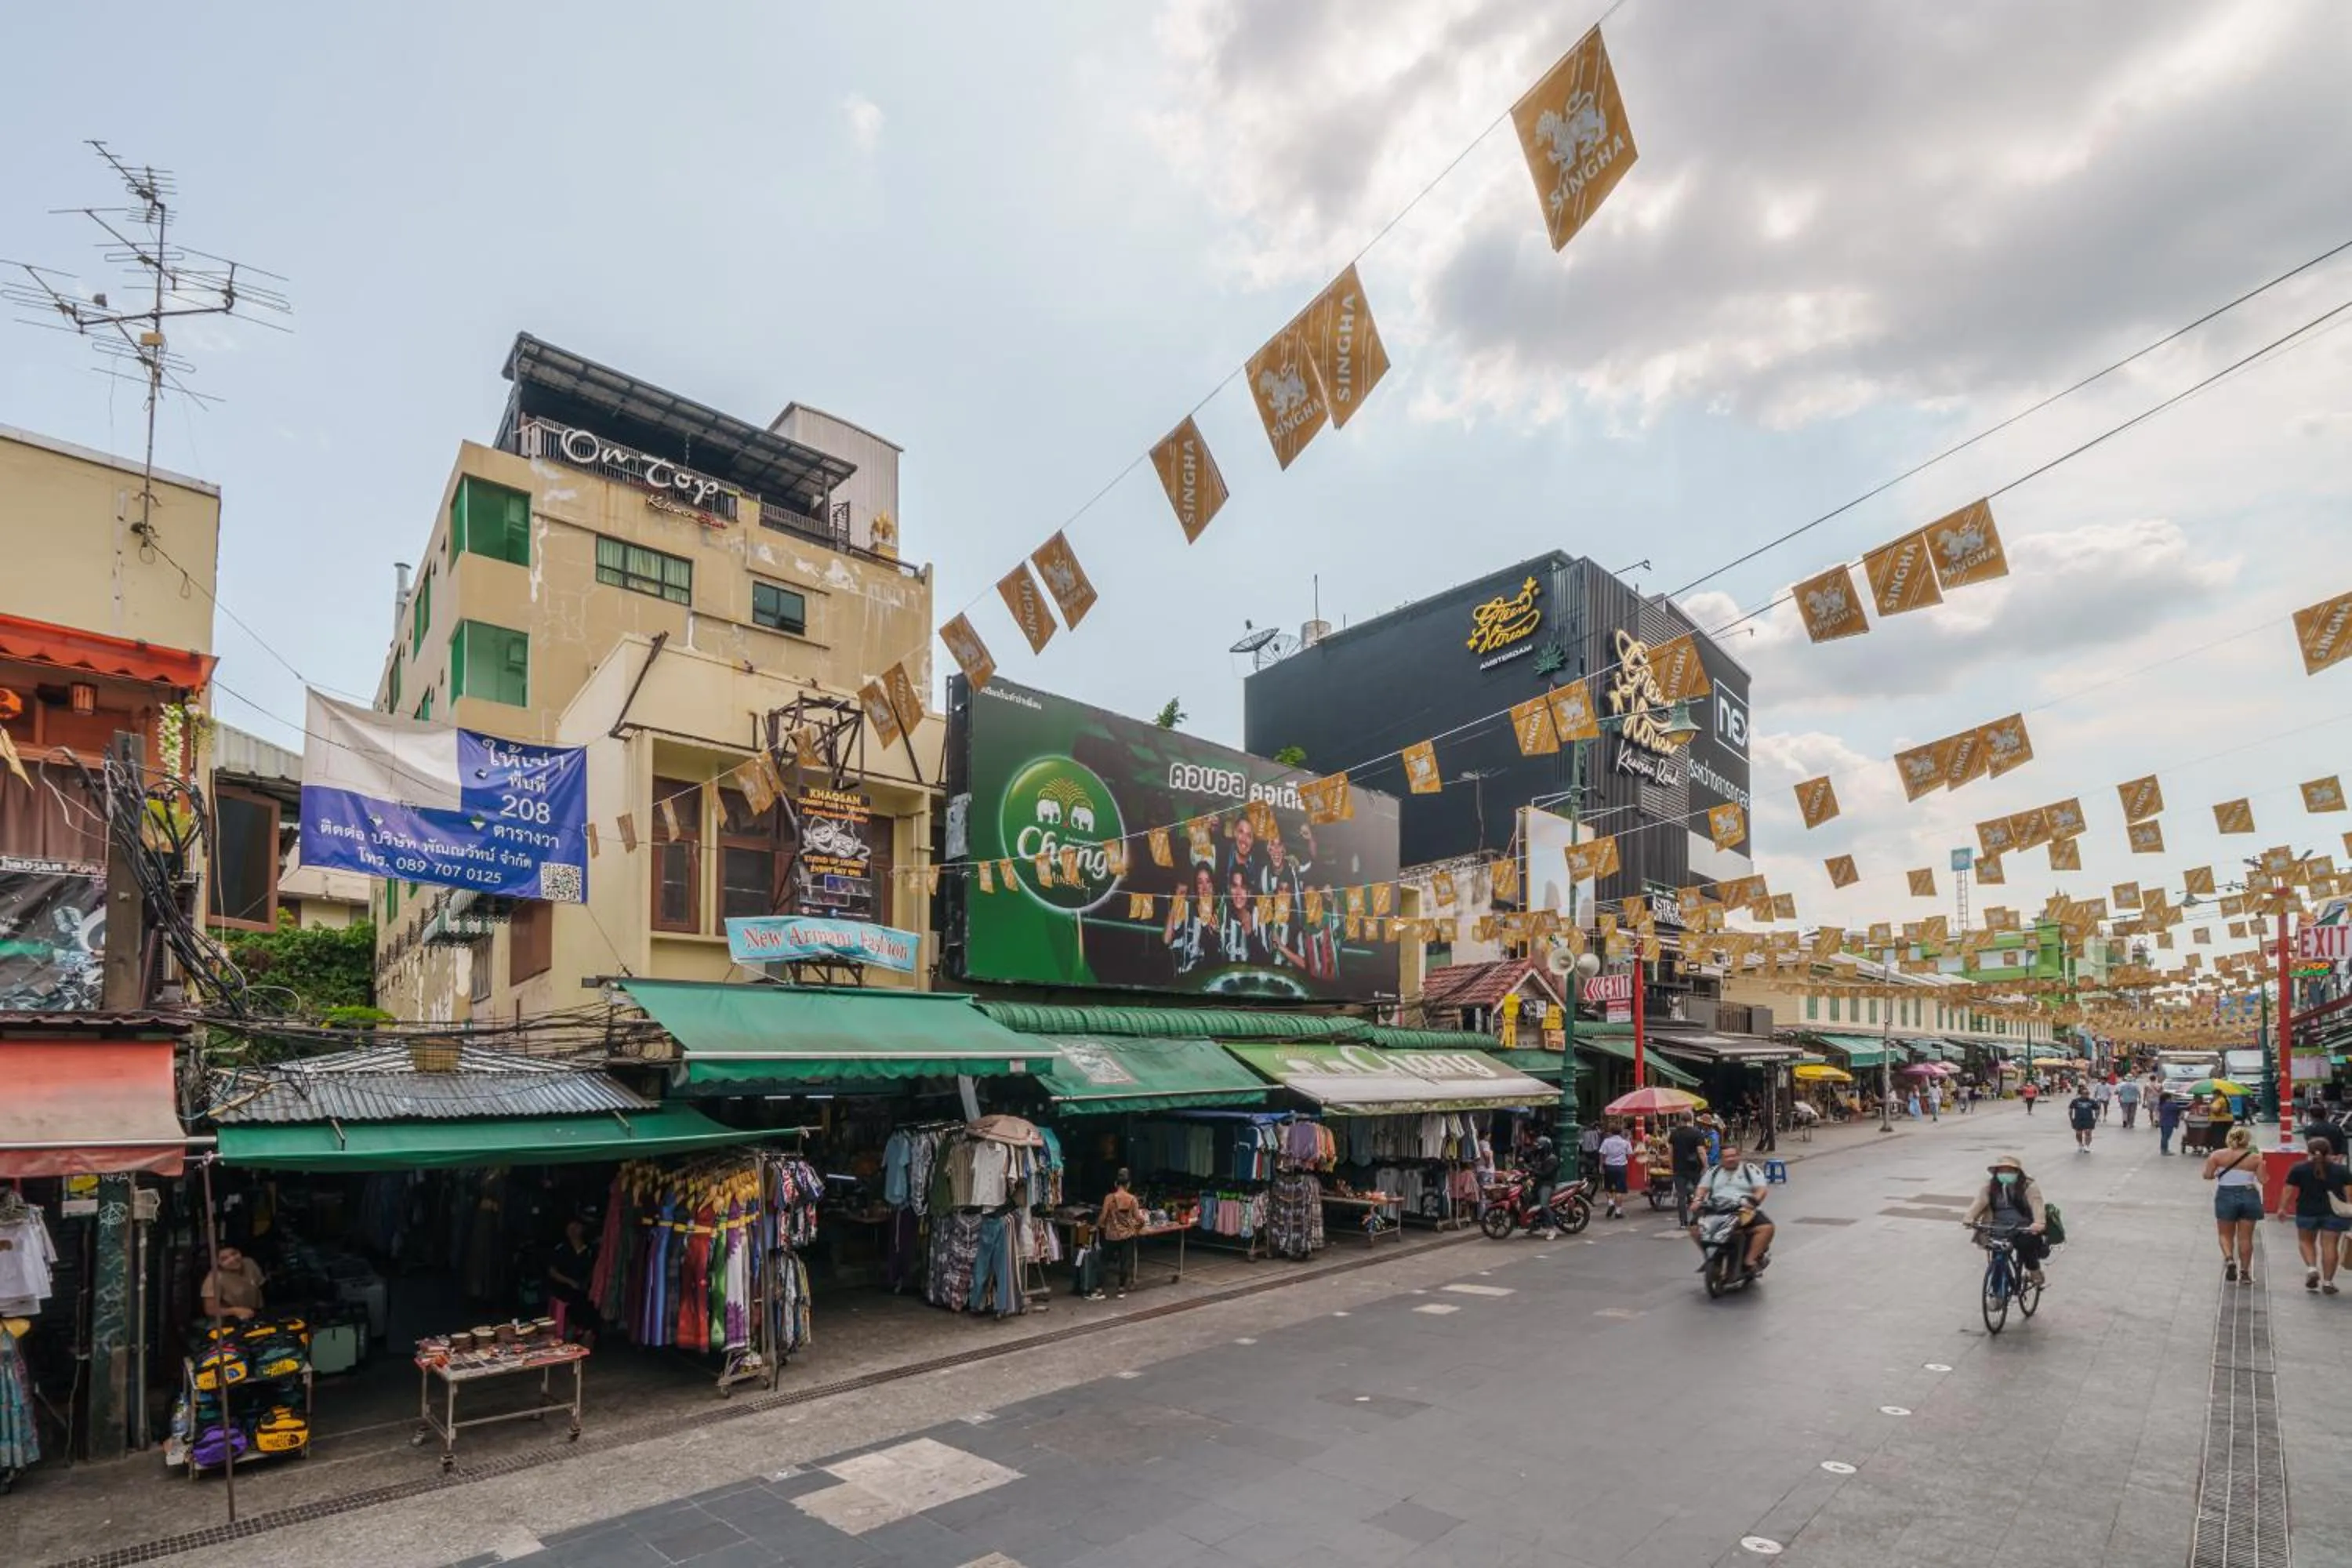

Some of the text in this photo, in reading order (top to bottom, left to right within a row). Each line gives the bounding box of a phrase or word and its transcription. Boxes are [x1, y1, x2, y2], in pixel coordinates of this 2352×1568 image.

[1548, 129, 1625, 210] SINGHA
[1337, 292, 1356, 402] SINGHA
[1271, 397, 1323, 441] SINGHA
[561, 427, 720, 506] On Top
[1182, 439, 1197, 524] SINGHA
[1884, 542, 1918, 610] SINGHA
[1021, 578, 1039, 641] SINGHA
[1479, 644, 1534, 670] AMSTERDAM
[1667, 644, 1688, 696] SINGHA
[1526, 705, 1544, 753] SINGHA
[1951, 736, 1976, 779] SINGHA
[808, 789, 862, 806] KHAOSAN
[1169, 762, 1247, 799] คอบอล
[499, 794, 551, 825] 208
[319, 818, 365, 843] ติดต่อ
[371, 831, 417, 850] บริษัท
[500, 851, 532, 869] จำกัด
[492, 823, 560, 850] ตารางวา
[1016, 826, 1108, 880] Chng
[358, 847, 503, 884] โทร. 089 707 0125
[743, 926, 908, 961] New Armani Fashion
[2300, 926, 2350, 958] EXIT
[1605, 976, 1628, 998] EXIT
